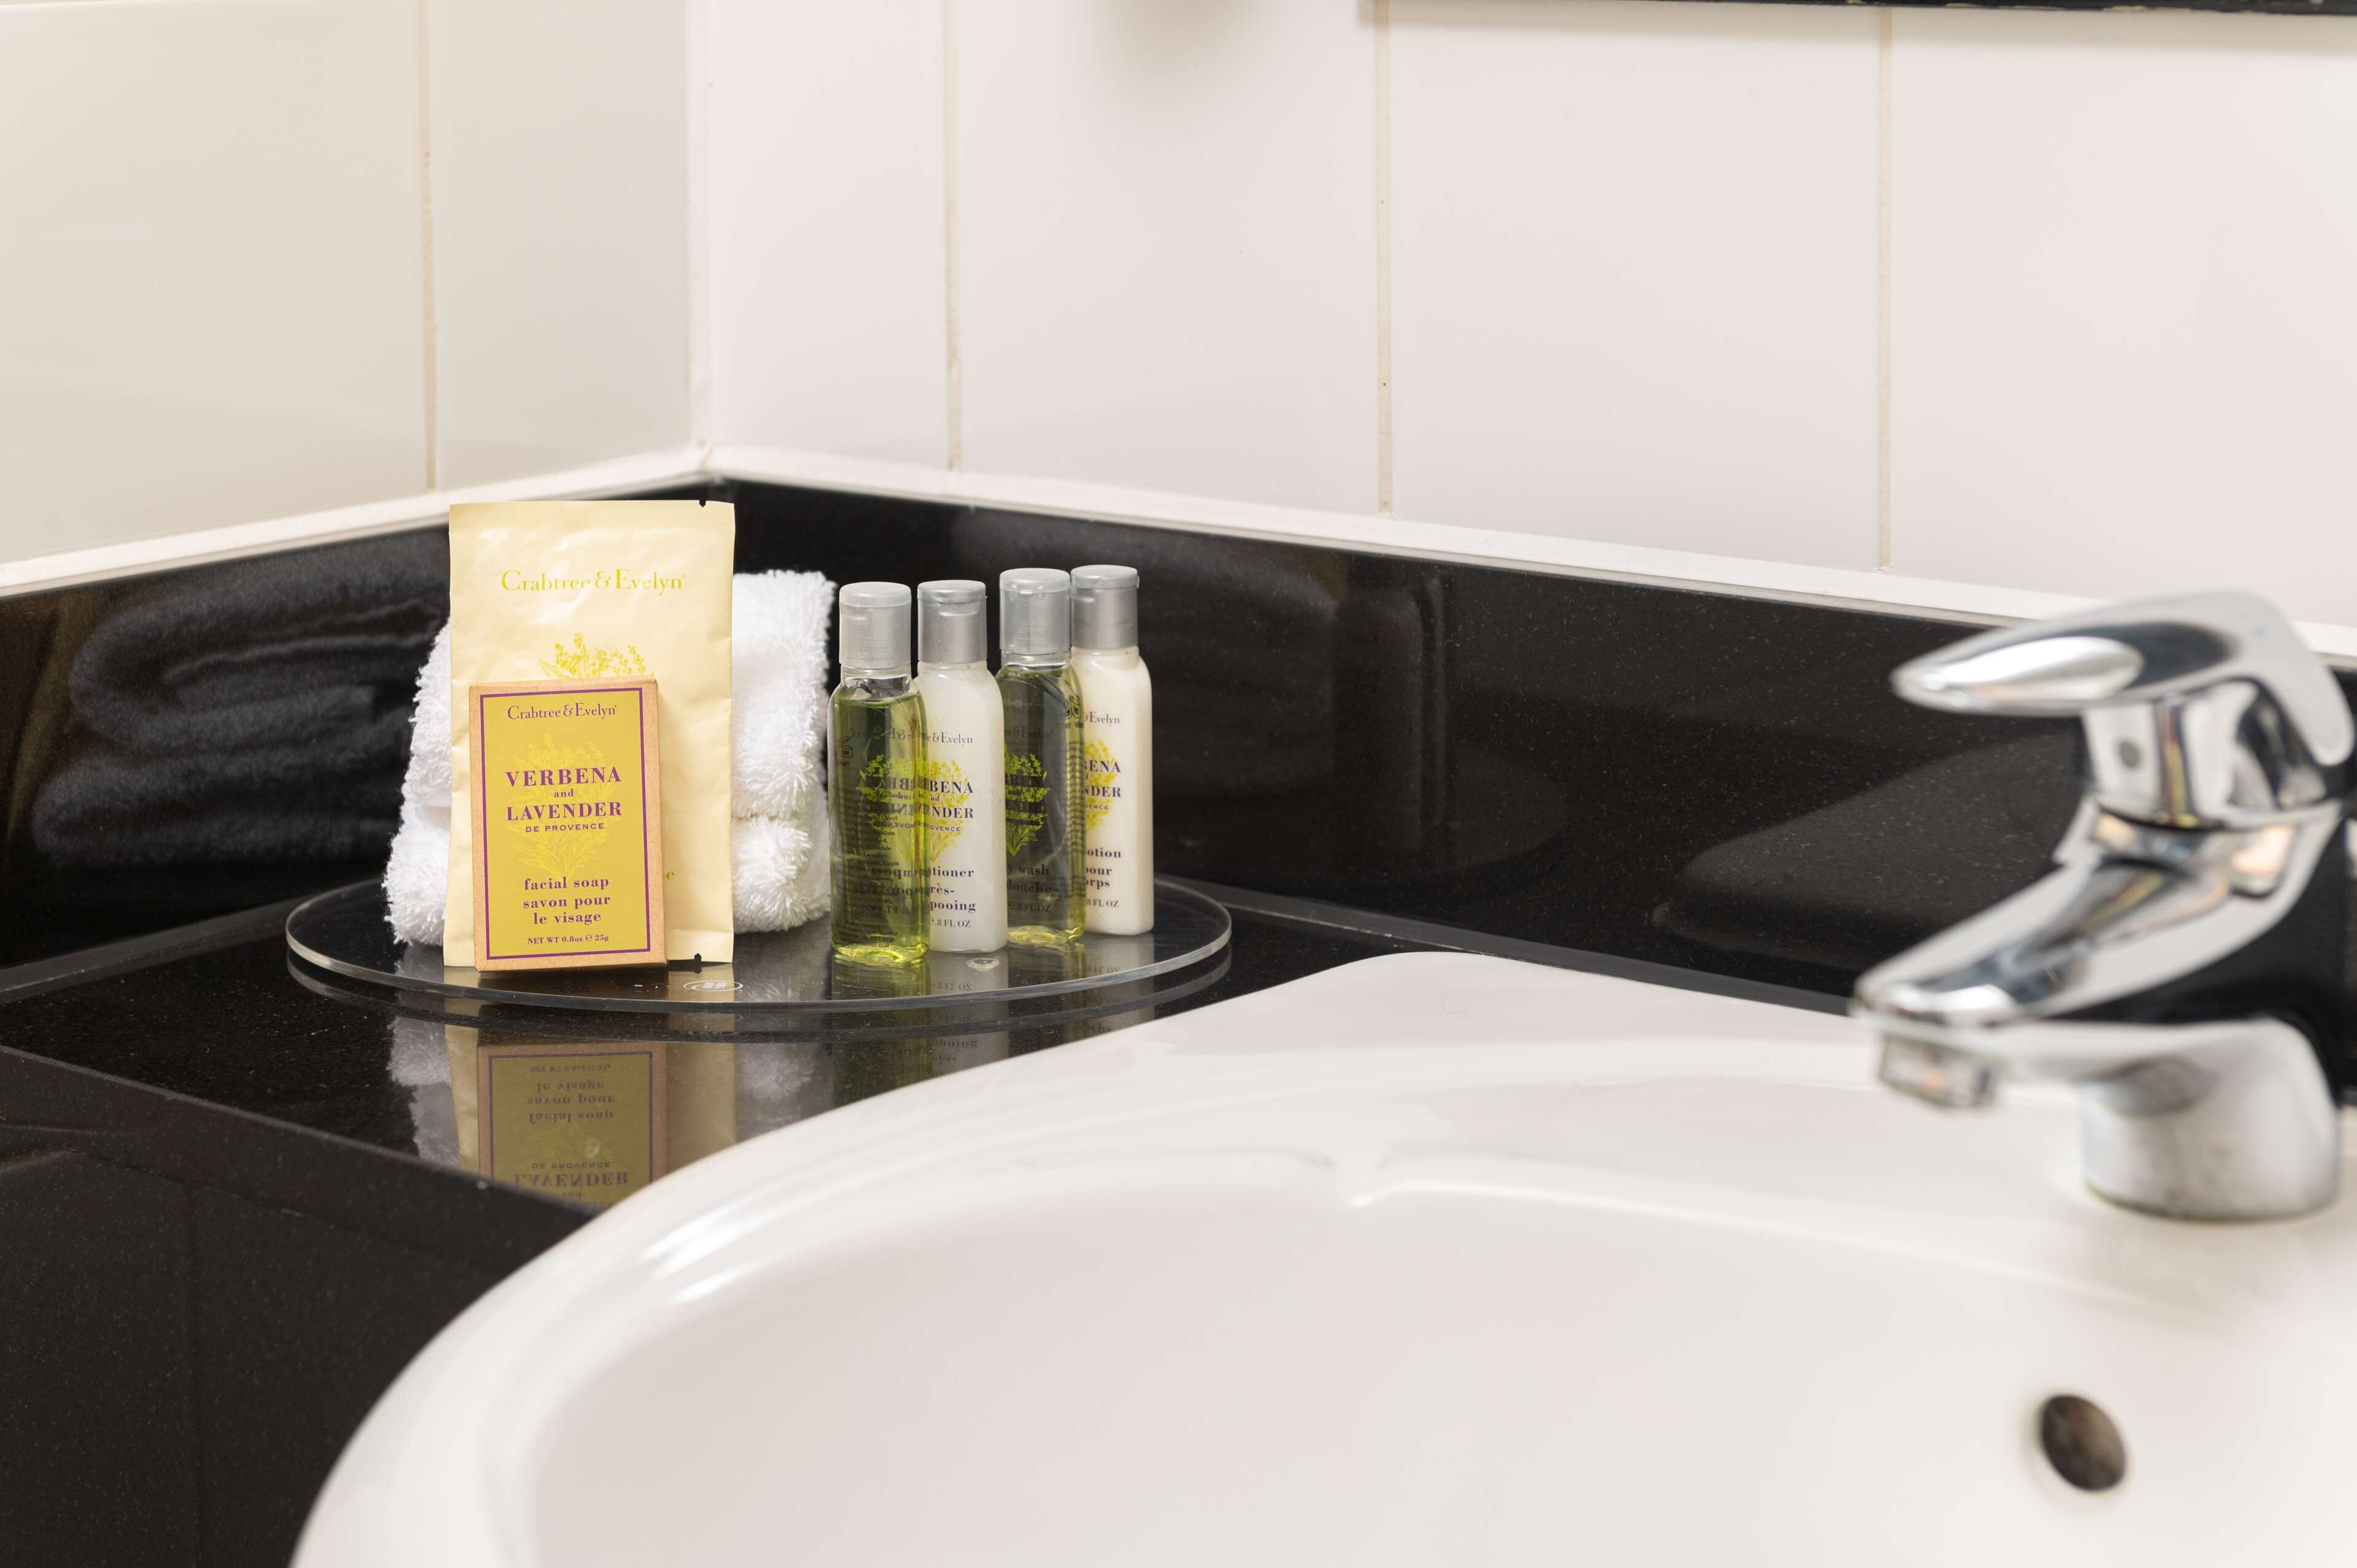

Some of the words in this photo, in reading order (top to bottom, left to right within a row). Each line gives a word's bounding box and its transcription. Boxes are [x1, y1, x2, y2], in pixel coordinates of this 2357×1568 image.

[501, 569, 591, 591] Crabtree
[594, 570, 612, 589] &
[615, 569, 683, 596] Evelyn
[507, 705, 561, 720] Crabtree
[563, 704, 573, 716] &
[575, 702, 616, 719] Evelyn
[1089, 711, 1120, 726] Evelyn
[941, 731, 973, 747] Evelyn
[505, 766, 622, 787] VERBENA
[554, 788, 574, 798] and
[929, 780, 974, 793] BENA
[506, 801, 622, 821] LAVENDER
[931, 806, 974, 818] NDER
[545, 823, 604, 832] PROVENCE
[1087, 847, 1121, 858] otion
[933, 866, 974, 877] tioner
[524, 877, 567, 890] facial
[573, 879, 609, 890] soap
[930, 883, 955, 895] rès-
[523, 898, 567, 909] savon
[574, 896, 611, 909] pour
[930, 900, 976, 914] pooing
[533, 912, 547, 925] le
[554, 912, 602, 925] visage
